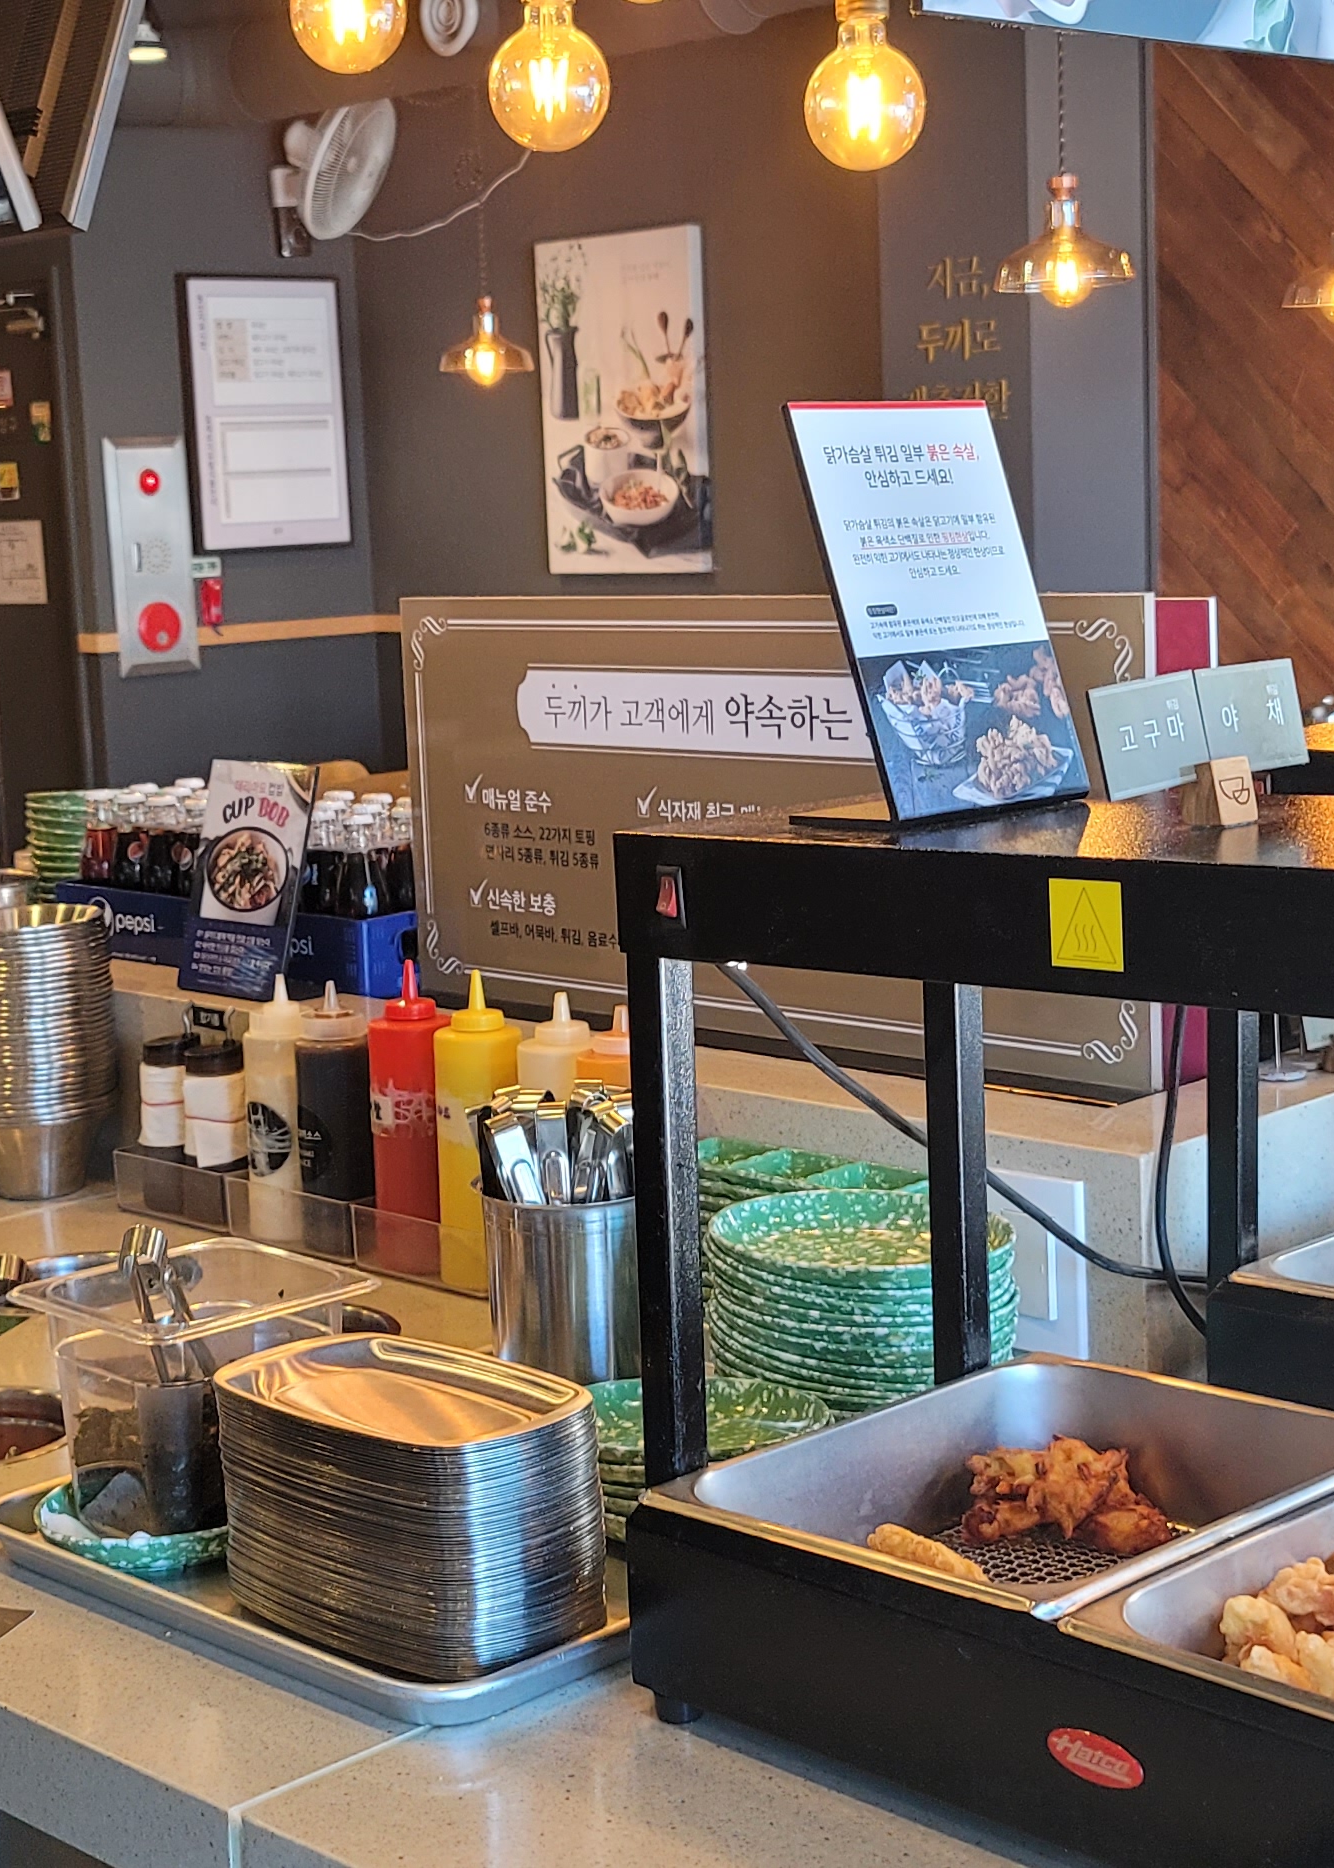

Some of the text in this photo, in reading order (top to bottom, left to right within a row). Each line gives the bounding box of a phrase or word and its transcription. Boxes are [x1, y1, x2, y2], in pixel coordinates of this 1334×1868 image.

[927, 256, 988, 299] 지금,
[917, 318, 1001, 364] 두끼로
[823, 442, 979, 465] 닭가슴살 튀김 일부 붉은 속살,
[865, 468, 954, 488] 안심하고 드세요!
[843, 519, 872, 531] 닭가슴살
[544, 693, 854, 741] 두끼가 고객에게 약속하는
[222, 795, 255, 824] CUP
[482, 787, 551, 814] 매뉴얼 준수
[657, 799, 701, 822] 식자재
[484, 823, 596, 846] 6종류 소스, 22가지 토핑
[517, 847, 547, 866] 5종류,
[549, 849, 569, 868] 튀김
[572, 852, 599, 869] 5종류
[486, 888, 556, 916] 신속한 보충
[115, 914, 156, 935] pepsi
[490, 920, 522, 940] 셀프바,
[524, 922, 557, 943] 어묵바,
[290, 936, 314, 958] psi
[1051, 1734, 1132, 1780] Hatco
